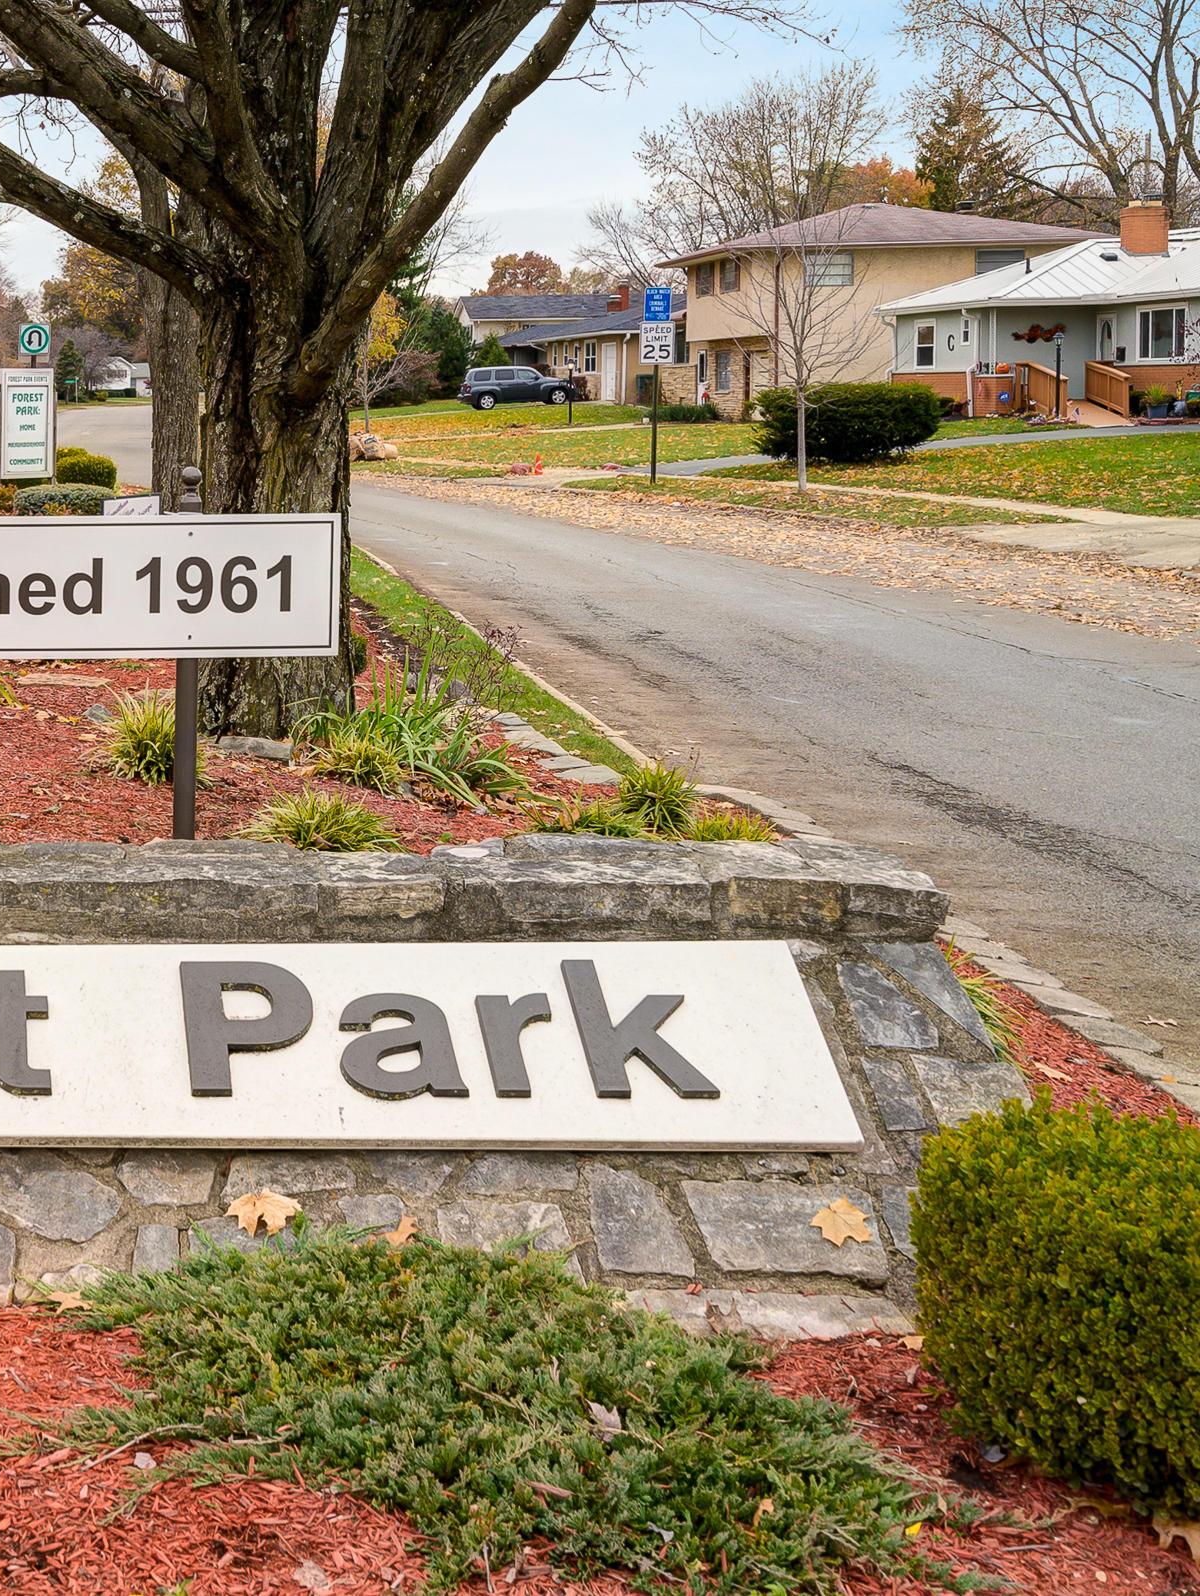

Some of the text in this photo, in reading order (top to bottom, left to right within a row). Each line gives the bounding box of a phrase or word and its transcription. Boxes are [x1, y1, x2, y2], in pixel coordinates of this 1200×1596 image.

[643, 326, 672, 334] SPEED
[947, 334, 955, 351] C
[643, 344, 671, 359] 25
[12, 393, 44, 403] FOREST
[15, 406, 41, 416] PARK:
[9, 458, 43, 466] COMMUNITY
[136, 555, 292, 614] 1961
[179, 959, 721, 1102] Park
